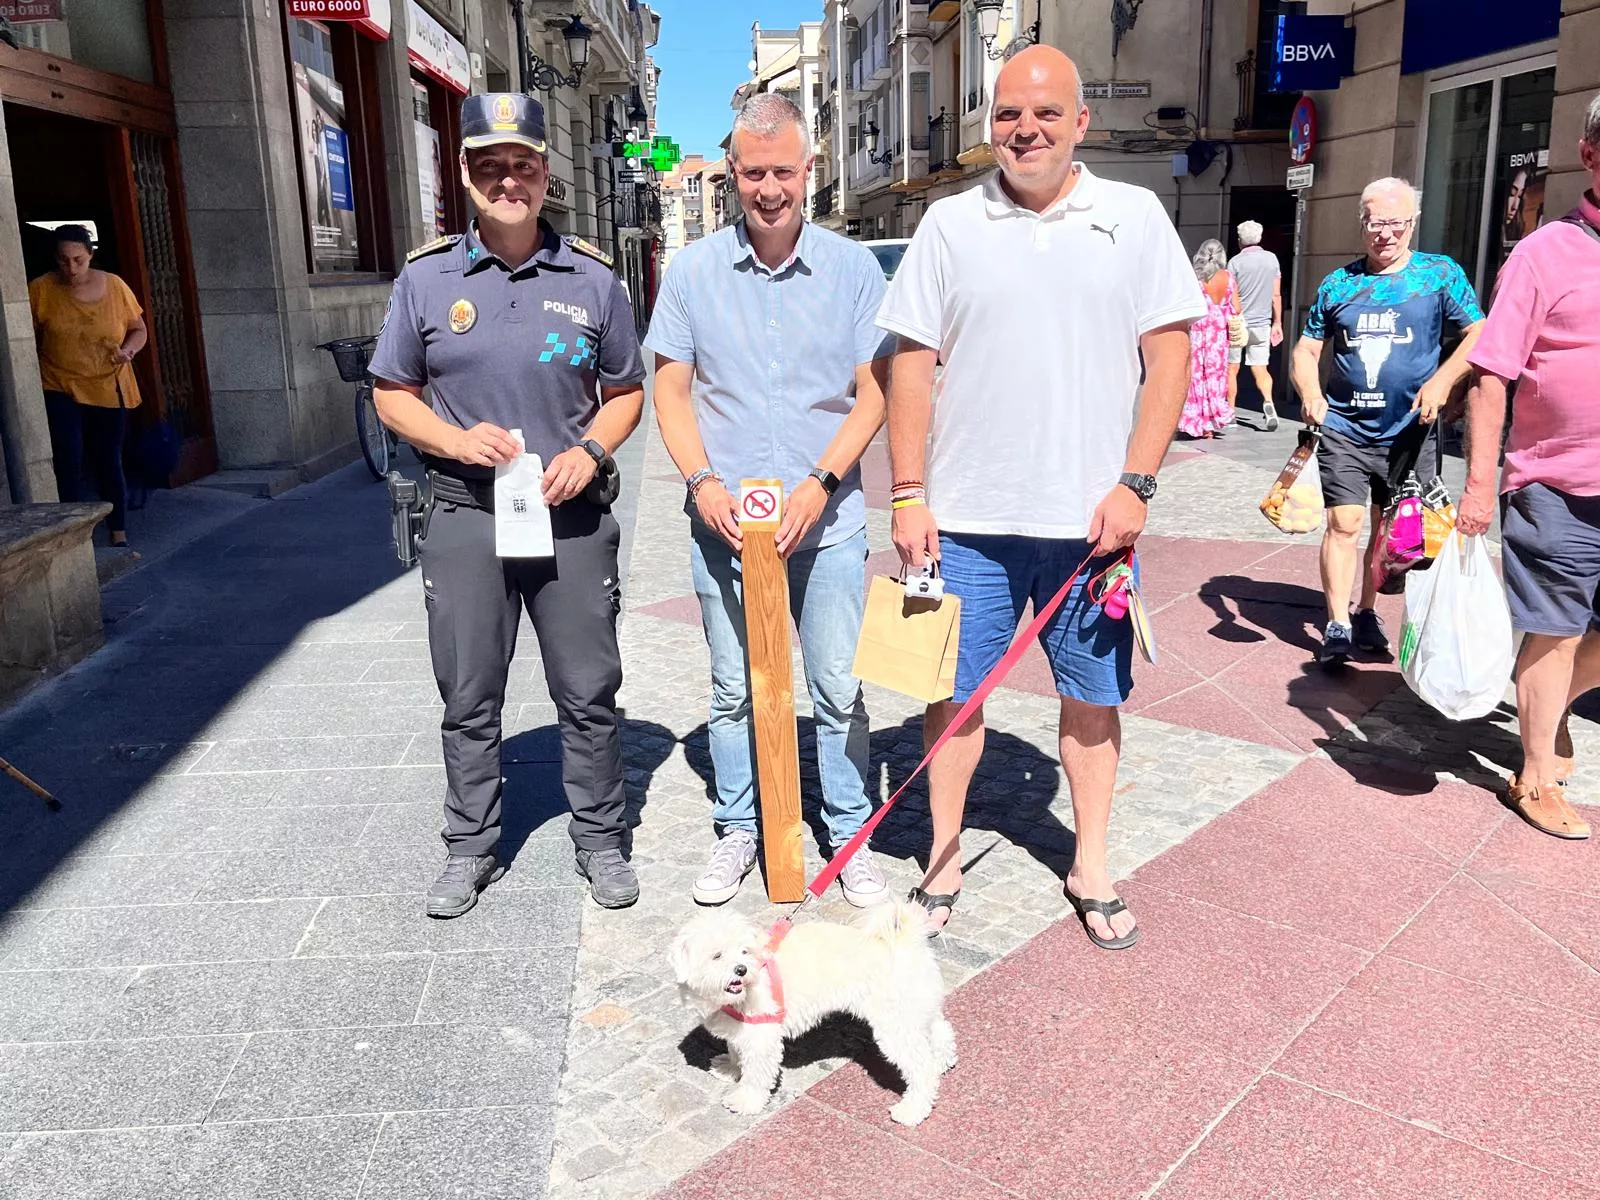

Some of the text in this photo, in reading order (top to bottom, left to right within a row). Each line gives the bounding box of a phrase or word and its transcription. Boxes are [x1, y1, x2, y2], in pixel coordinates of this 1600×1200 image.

[293, 0, 361, 12] EURO 6000
[1282, 42, 1336, 62] BBVA
[1510, 151, 1535, 168] BBVA
[543, 300, 588, 320] POLICIA
